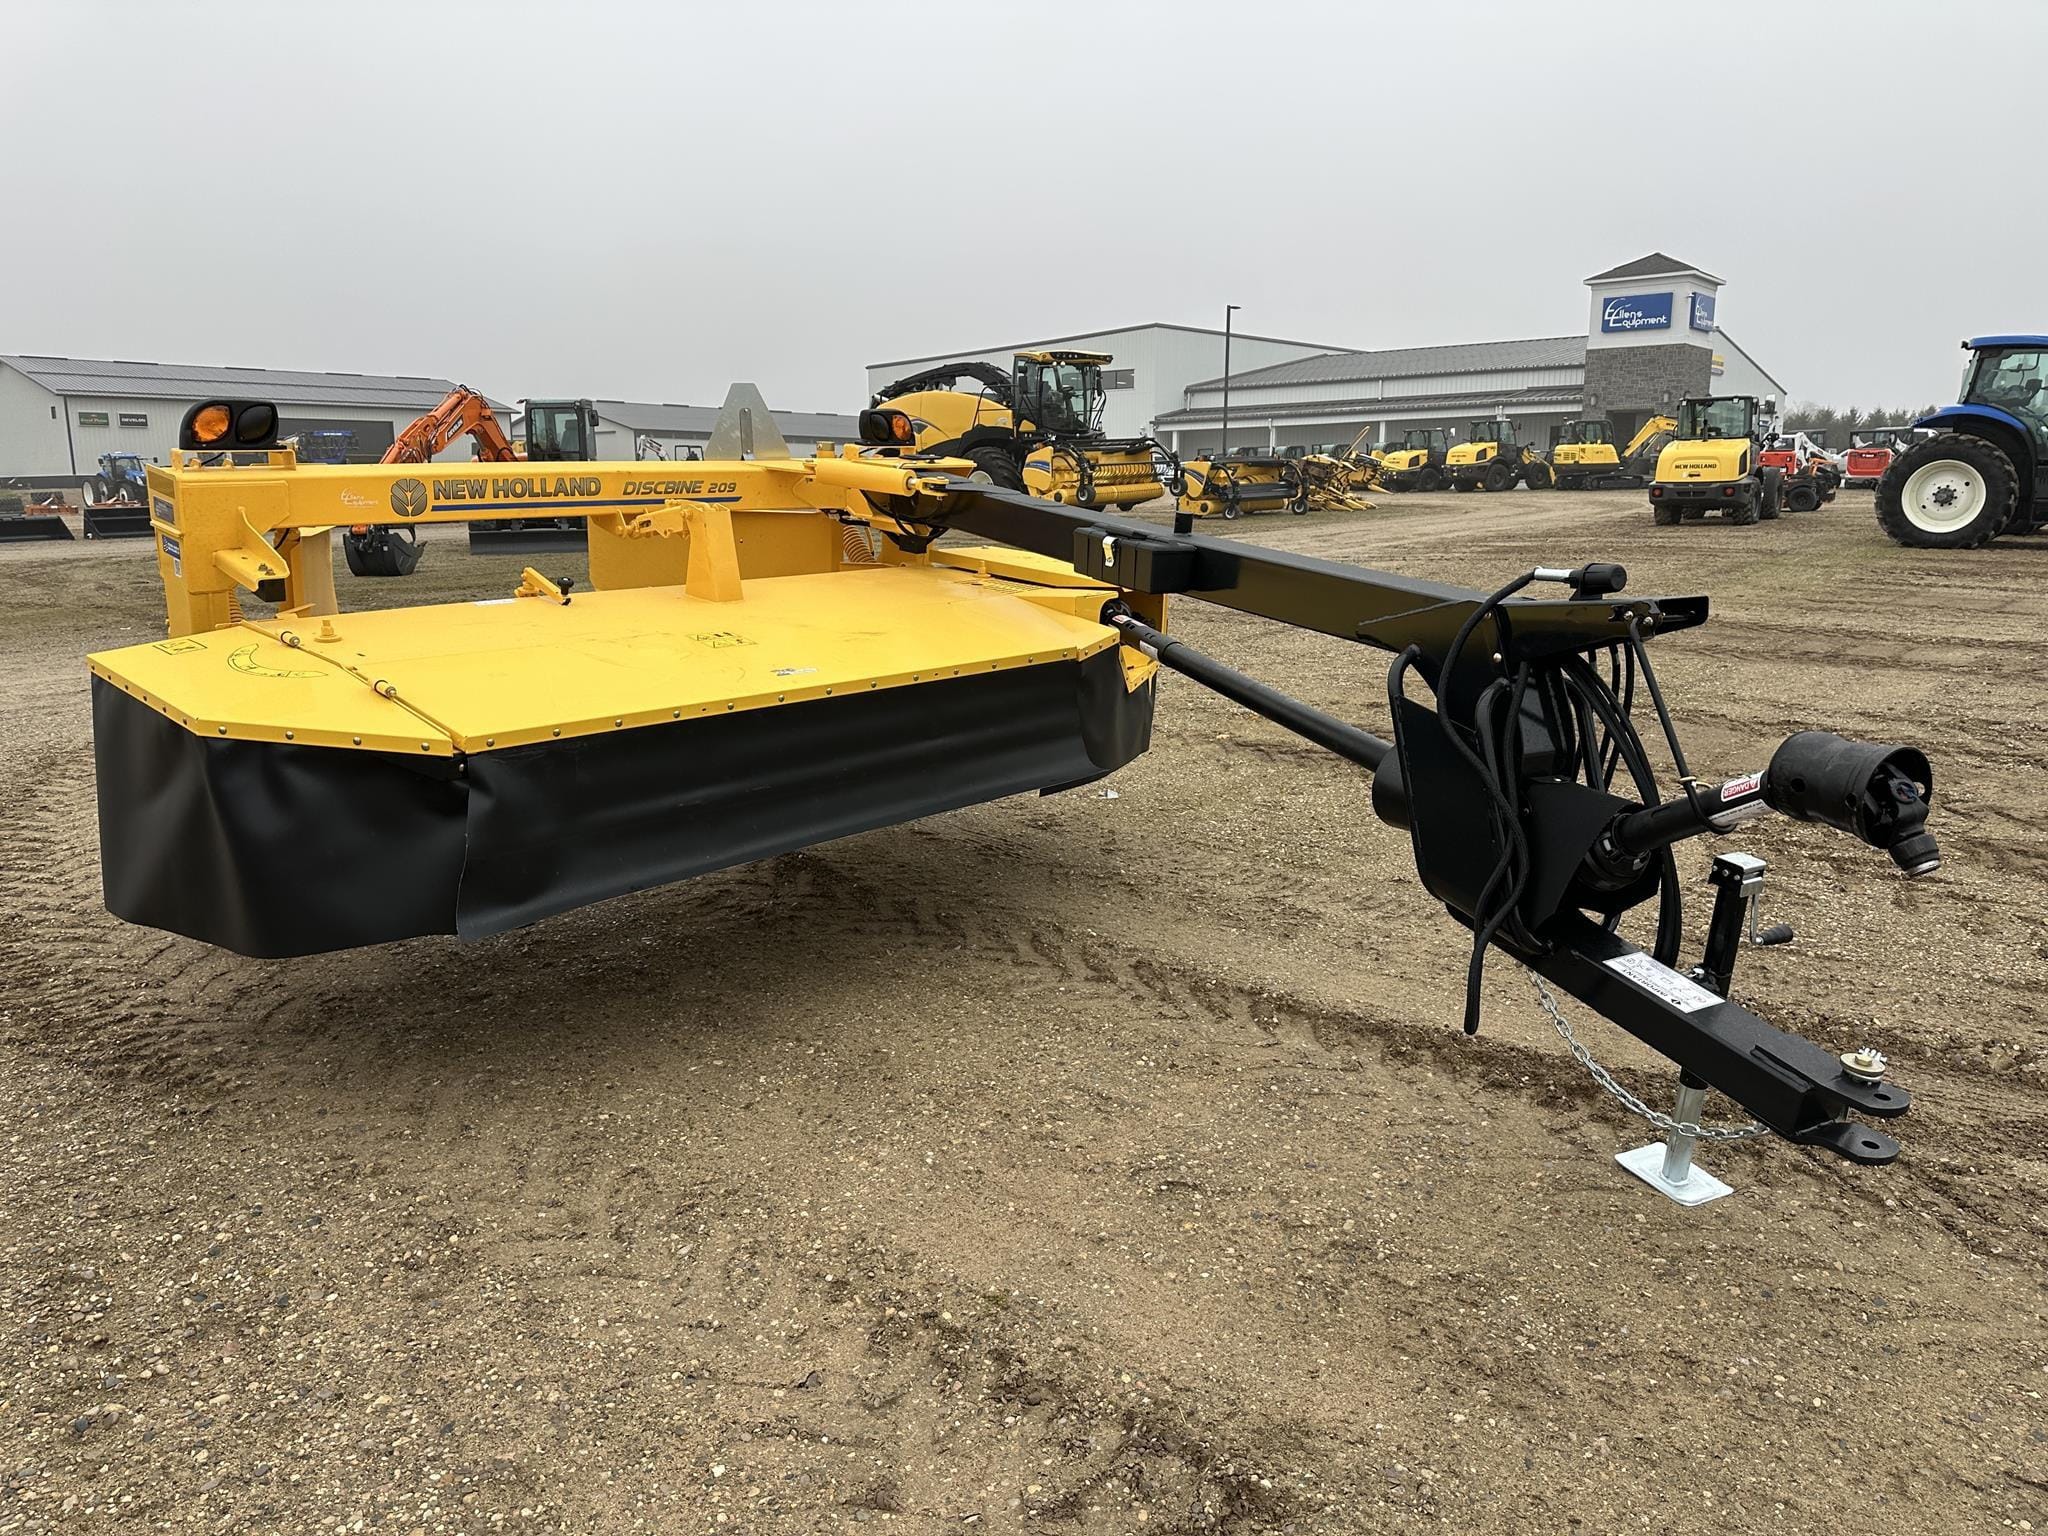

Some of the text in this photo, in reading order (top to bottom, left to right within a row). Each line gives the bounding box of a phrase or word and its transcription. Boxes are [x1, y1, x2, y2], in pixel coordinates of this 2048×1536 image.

[1609, 303, 1668, 329] Equipment
[433, 477, 602, 500] NEW HOLLAND
[622, 480, 737, 496] DISCBINE 209
[1724, 783, 1750, 797] DANGER
[1623, 969, 1668, 998] IMPORTANT
